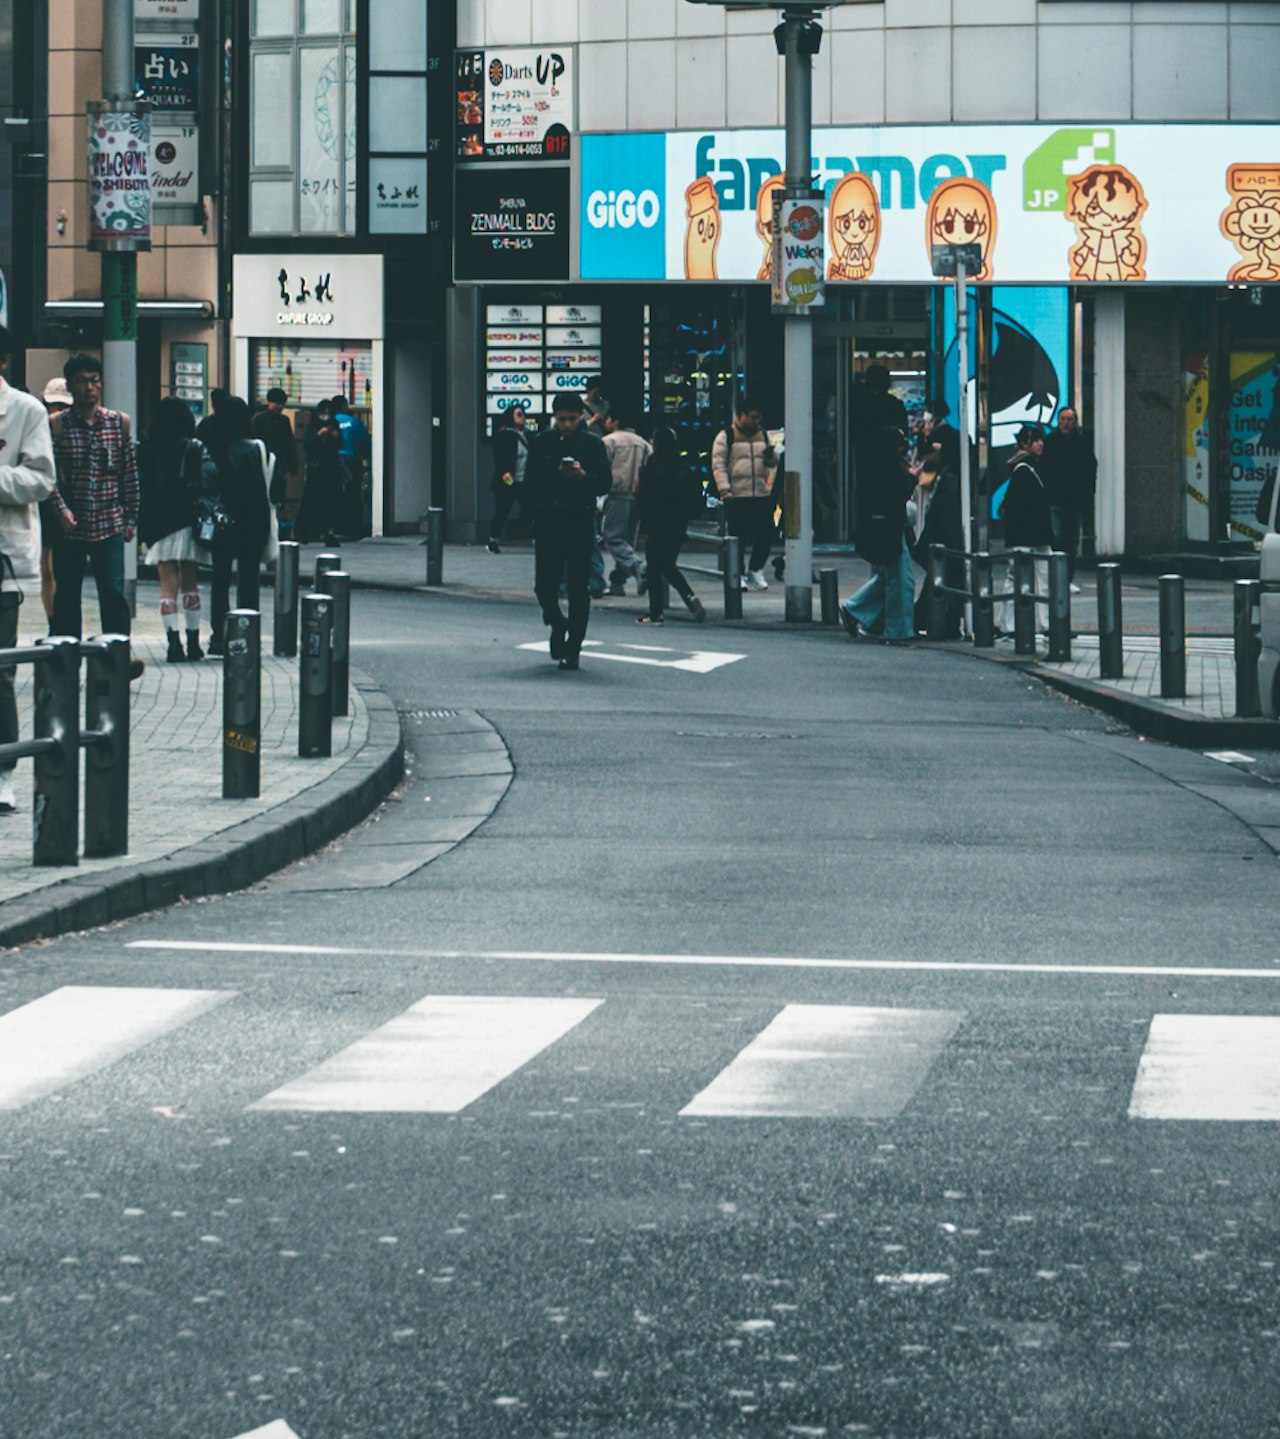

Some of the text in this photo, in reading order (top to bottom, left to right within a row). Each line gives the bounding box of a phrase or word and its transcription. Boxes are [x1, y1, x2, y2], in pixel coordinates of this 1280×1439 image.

[181, 35, 196, 46] 2F
[144, 52, 190, 80] 占い
[428, 57, 440, 69] 3F
[504, 63, 533, 80] Darts
[536, 53, 565, 86] UP
[182, 127, 196, 138] 1F
[429, 138, 440, 150] 2F
[545, 135, 568, 154] B1F
[92, 150, 147, 177] WELCOME
[1247, 175, 1280, 187] ハロー!
[376, 182, 420, 200] ちふれ
[1026, 188, 1060, 208] JP
[499, 197, 527, 209] SHIBUYA
[586, 188, 661, 230] GiGO
[471, 212, 556, 232] ZENMALL BLDG
[277, 267, 334, 307] ちふれ
[308, 312, 334, 325] GROUP
[501, 374, 529, 385] GiGO
[1230, 388, 1263, 409] Get
